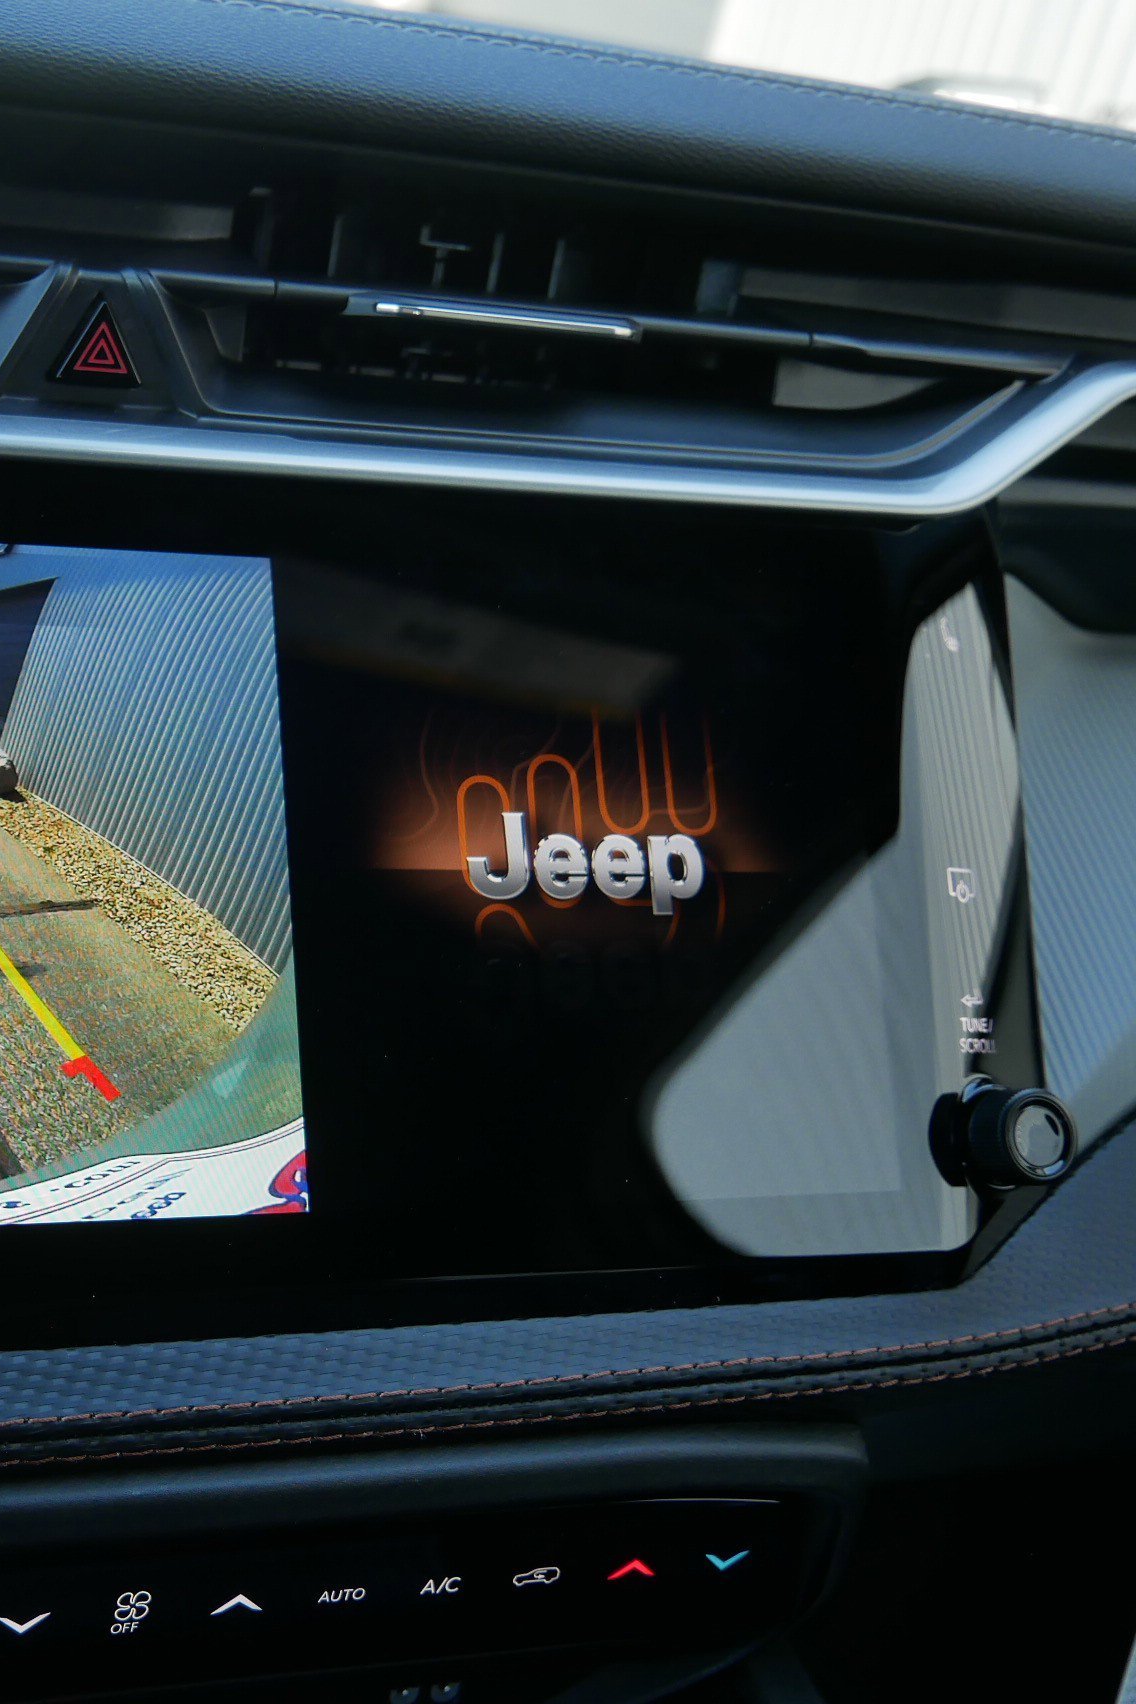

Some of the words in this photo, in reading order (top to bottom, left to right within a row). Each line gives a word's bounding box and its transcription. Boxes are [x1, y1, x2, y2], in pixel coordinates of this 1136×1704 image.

[466, 811, 705, 916] Jeep
[317, 1587, 366, 1603] AUTO
[420, 1576, 462, 1596] A/C
[110, 1621, 139, 1635] OFF
